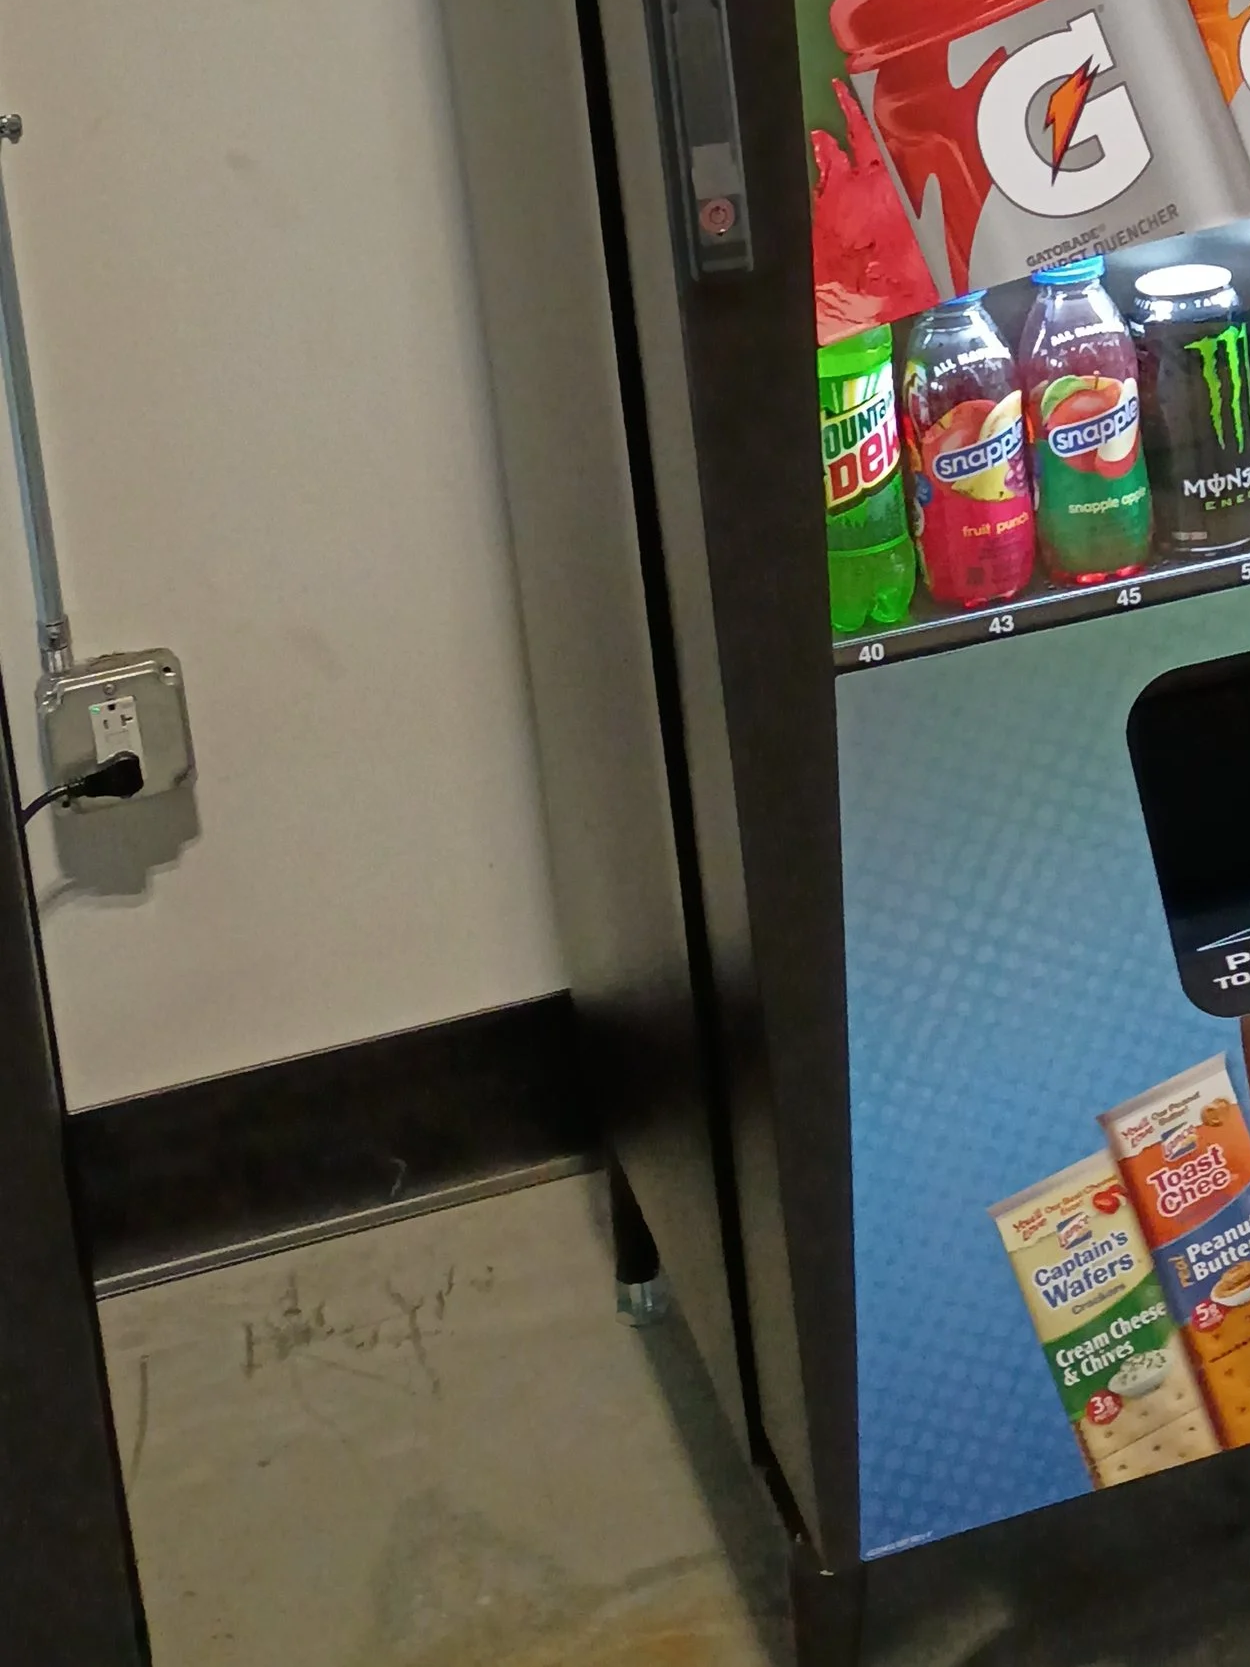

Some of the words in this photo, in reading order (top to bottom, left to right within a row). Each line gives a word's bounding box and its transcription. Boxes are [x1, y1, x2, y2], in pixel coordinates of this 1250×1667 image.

[976, 10, 1154, 219] G
[1025, 227, 1101, 268] GATORADE
[1093, 202, 1180, 258] QUENCHER
[1055, 396, 1139, 452] snapple
[962, 524, 992, 538] fruit
[1068, 499, 1120, 515] snapple
[1116, 588, 1142, 606] 45
[989, 615, 1014, 633] 43
[859, 644, 885, 662] 40
[1149, 1146, 1225, 1195] Toast
[1159, 1169, 1230, 1215] Chee
[1034, 1231, 1129, 1287] Captain's
[1042, 1253, 1135, 1309] Wafers
[1055, 1329, 1110, 1368] Cream
[1110, 1302, 1168, 1345] Cheese
[1063, 1369, 1079, 1387] &
[1079, 1338, 1135, 1378] Chives
